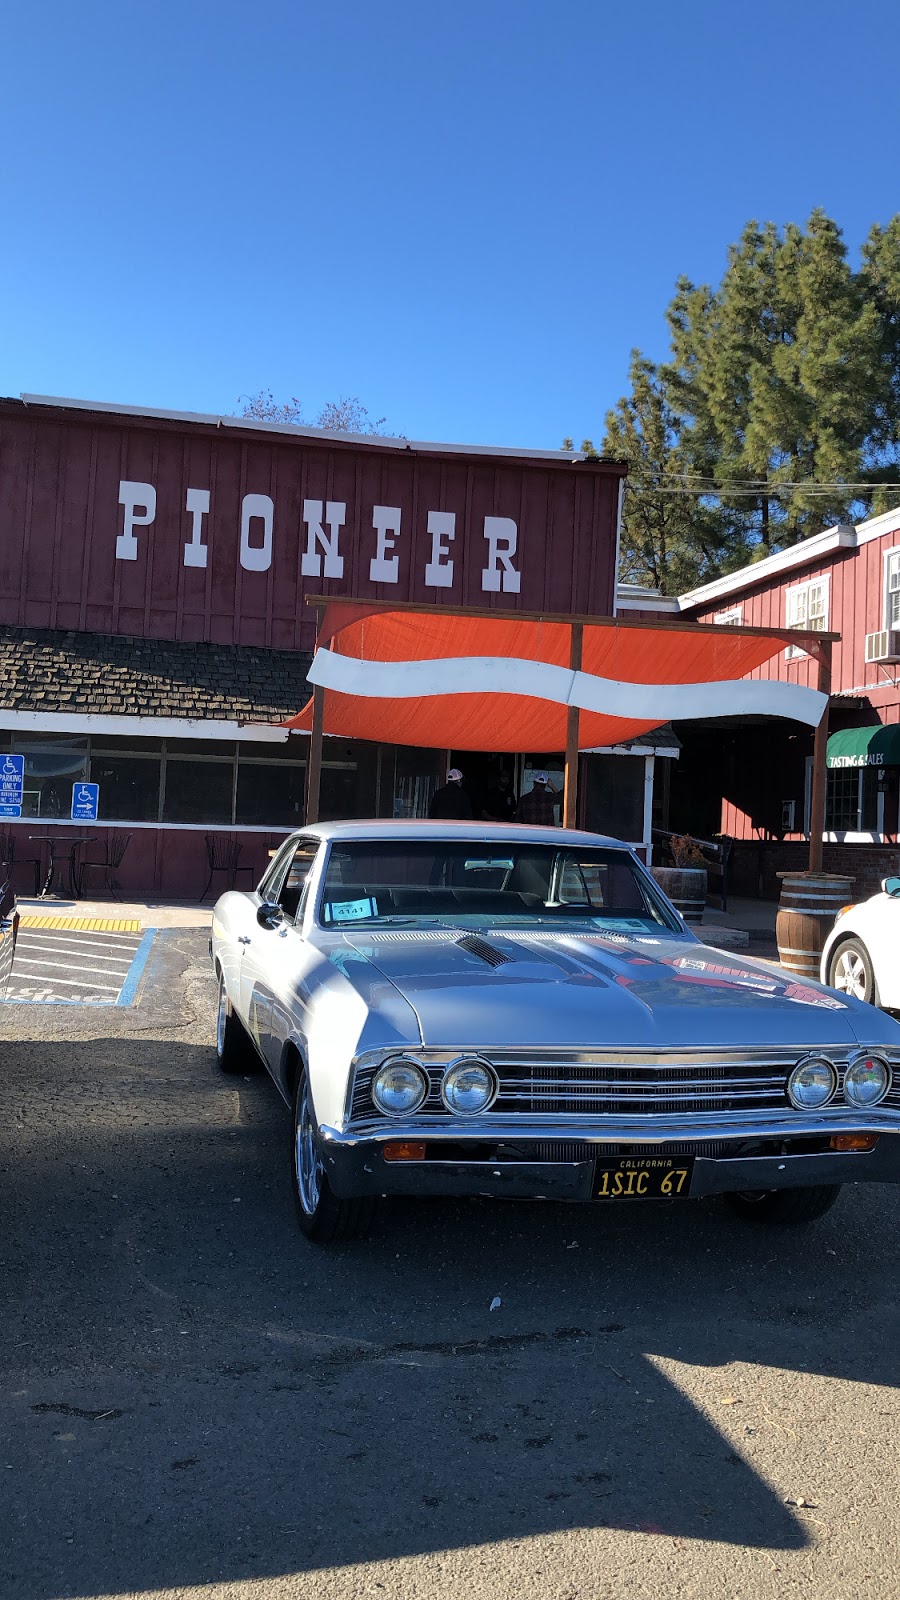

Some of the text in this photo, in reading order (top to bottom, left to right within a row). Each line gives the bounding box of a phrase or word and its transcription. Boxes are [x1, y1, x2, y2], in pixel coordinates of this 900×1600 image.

[116, 480, 521, 593] PIONEER
[830, 753, 884, 768] TASTING & SALES
[3, 782, 17, 790] ONLY
[338, 907, 363, 915] 4141
[620, 1160, 672, 1168] CALIFORNIA
[598, 1170, 688, 1196] 1SIC 67
